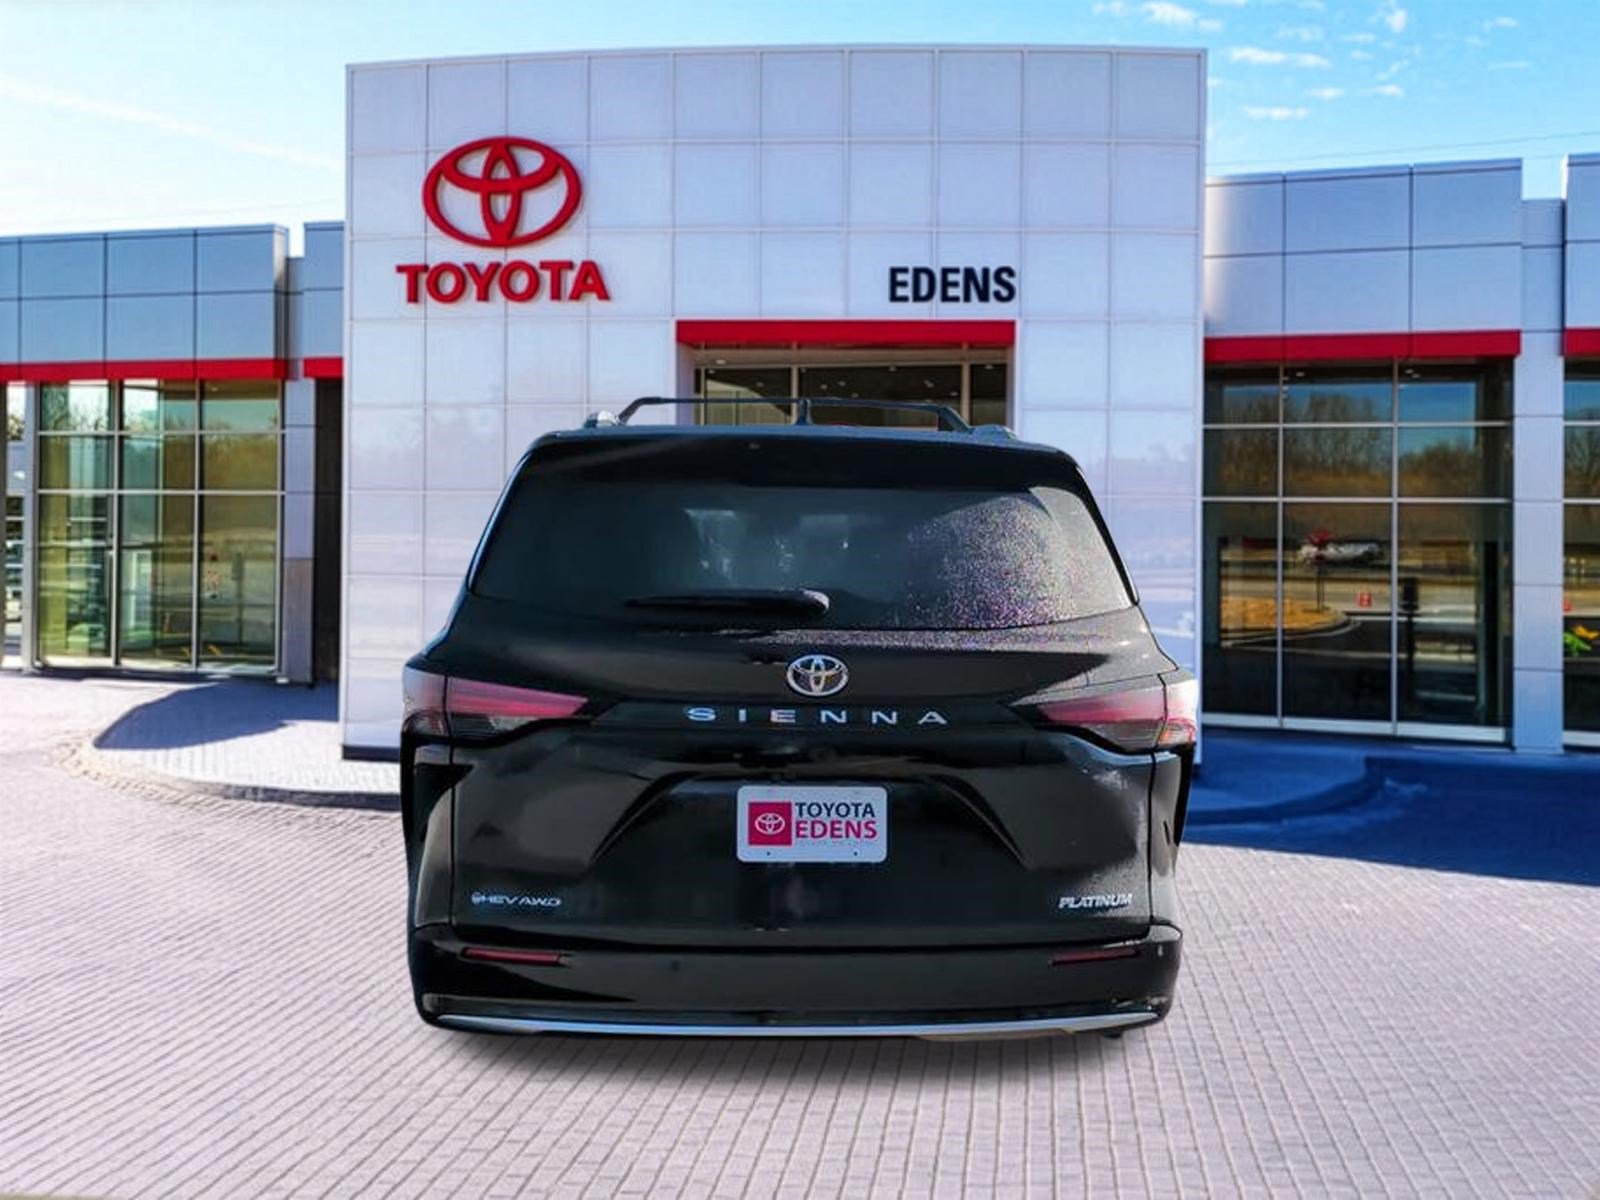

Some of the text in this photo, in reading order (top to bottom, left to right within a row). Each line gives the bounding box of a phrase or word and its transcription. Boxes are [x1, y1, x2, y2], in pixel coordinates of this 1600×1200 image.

[396, 260, 611, 304] TOYOTA
[889, 266, 1016, 303] EDENS
[687, 707, 948, 725] SIENNA
[795, 802, 875, 818] TOYOTA
[795, 820, 877, 839] EDENS
[1058, 893, 1133, 909] PLATINUM
